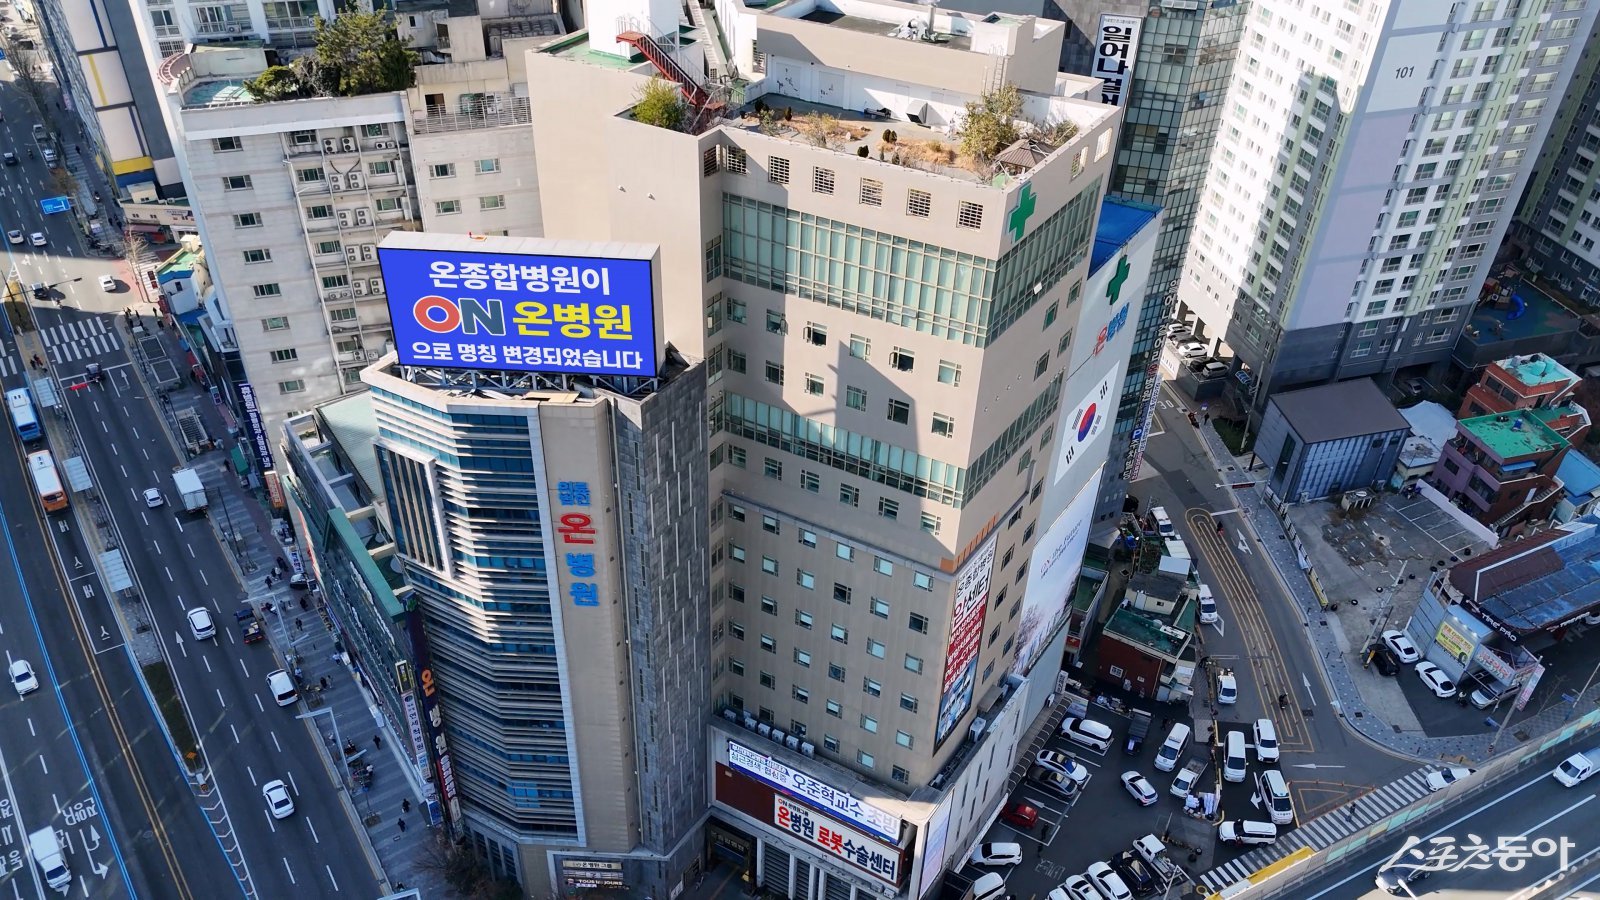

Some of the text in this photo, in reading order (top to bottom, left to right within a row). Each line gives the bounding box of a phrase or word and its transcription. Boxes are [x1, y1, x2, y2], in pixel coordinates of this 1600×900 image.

[1395, 66, 1415, 80] 101
[429, 261, 610, 296] 온종합병원이
[413, 295, 506, 336] ON
[512, 301, 633, 341] 온병원
[1092, 302, 1130, 357] 온병원
[412, 342, 643, 370] 으로 명칭 변경되었습니다
[1157, 400, 1175, 410] 30
[1132, 428, 1143, 439] P
[557, 513, 600, 607] 온병원
[954, 567, 991, 628] 암센터
[1481, 612, 1518, 642] TIRE PRO
[777, 805, 815, 840] 온병원
[792, 773, 898, 836] 오준혁교수 초빙
[817, 825, 896, 881] 로봇수술센터
